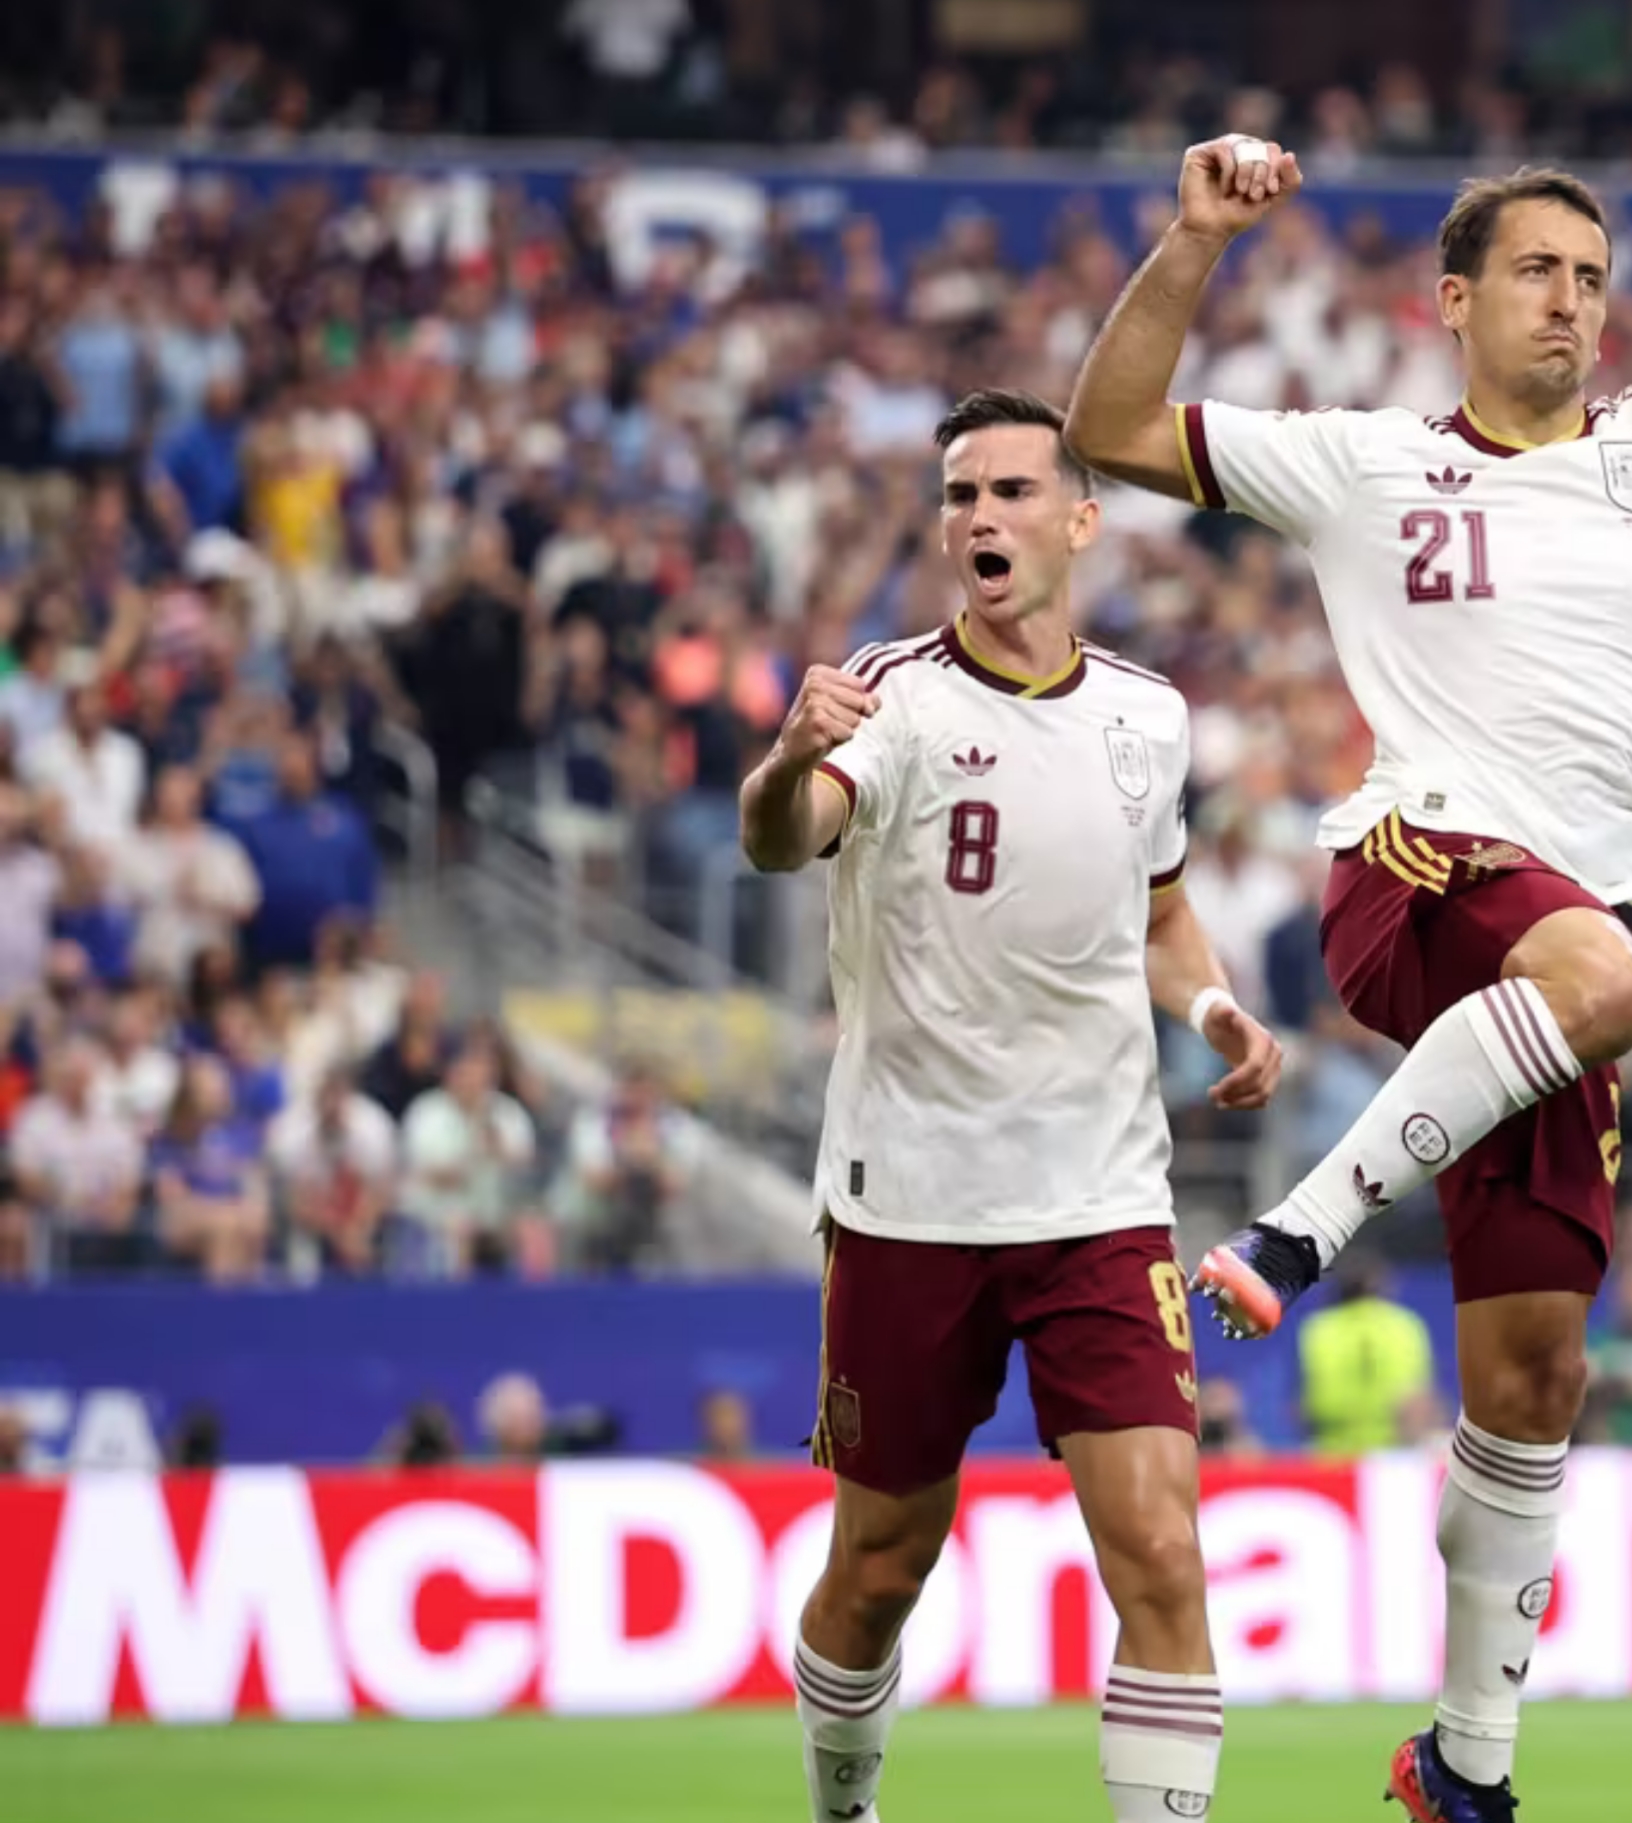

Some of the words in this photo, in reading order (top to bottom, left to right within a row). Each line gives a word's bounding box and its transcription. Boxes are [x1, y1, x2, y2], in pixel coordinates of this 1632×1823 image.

[1400, 509, 1496, 604] 21
[944, 799, 999, 895] 8
[1147, 1260, 1191, 1353] 8
